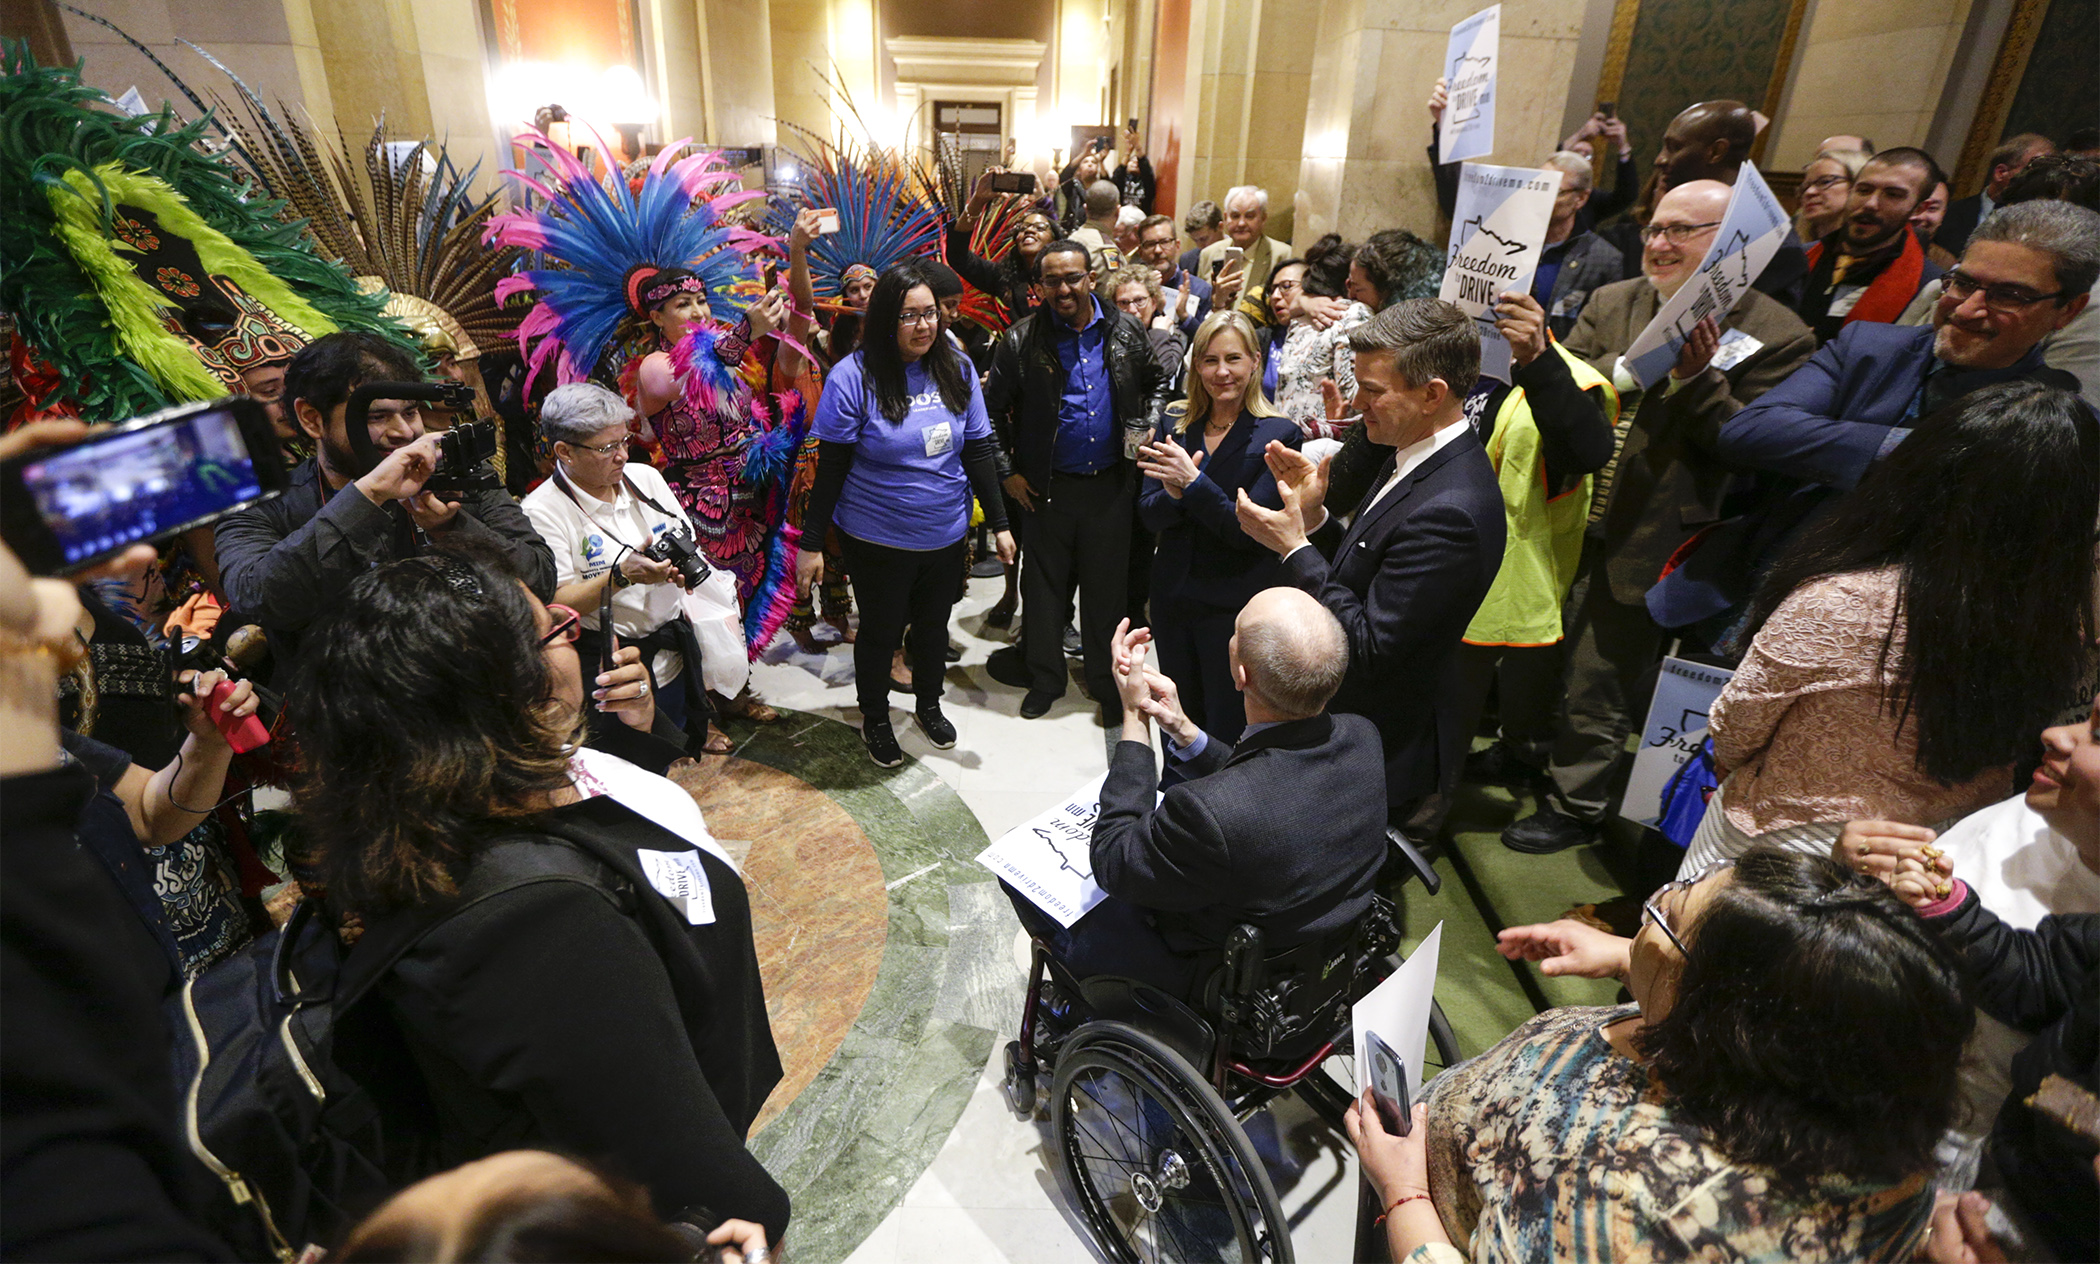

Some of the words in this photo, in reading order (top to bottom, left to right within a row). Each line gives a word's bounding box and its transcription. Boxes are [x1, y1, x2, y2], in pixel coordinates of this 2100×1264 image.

[1447, 244, 1518, 280] Freedom
[1459, 274, 1495, 306] DRIVE
[1673, 753, 1685, 764] to
[676, 870, 689, 897] DRIVE
